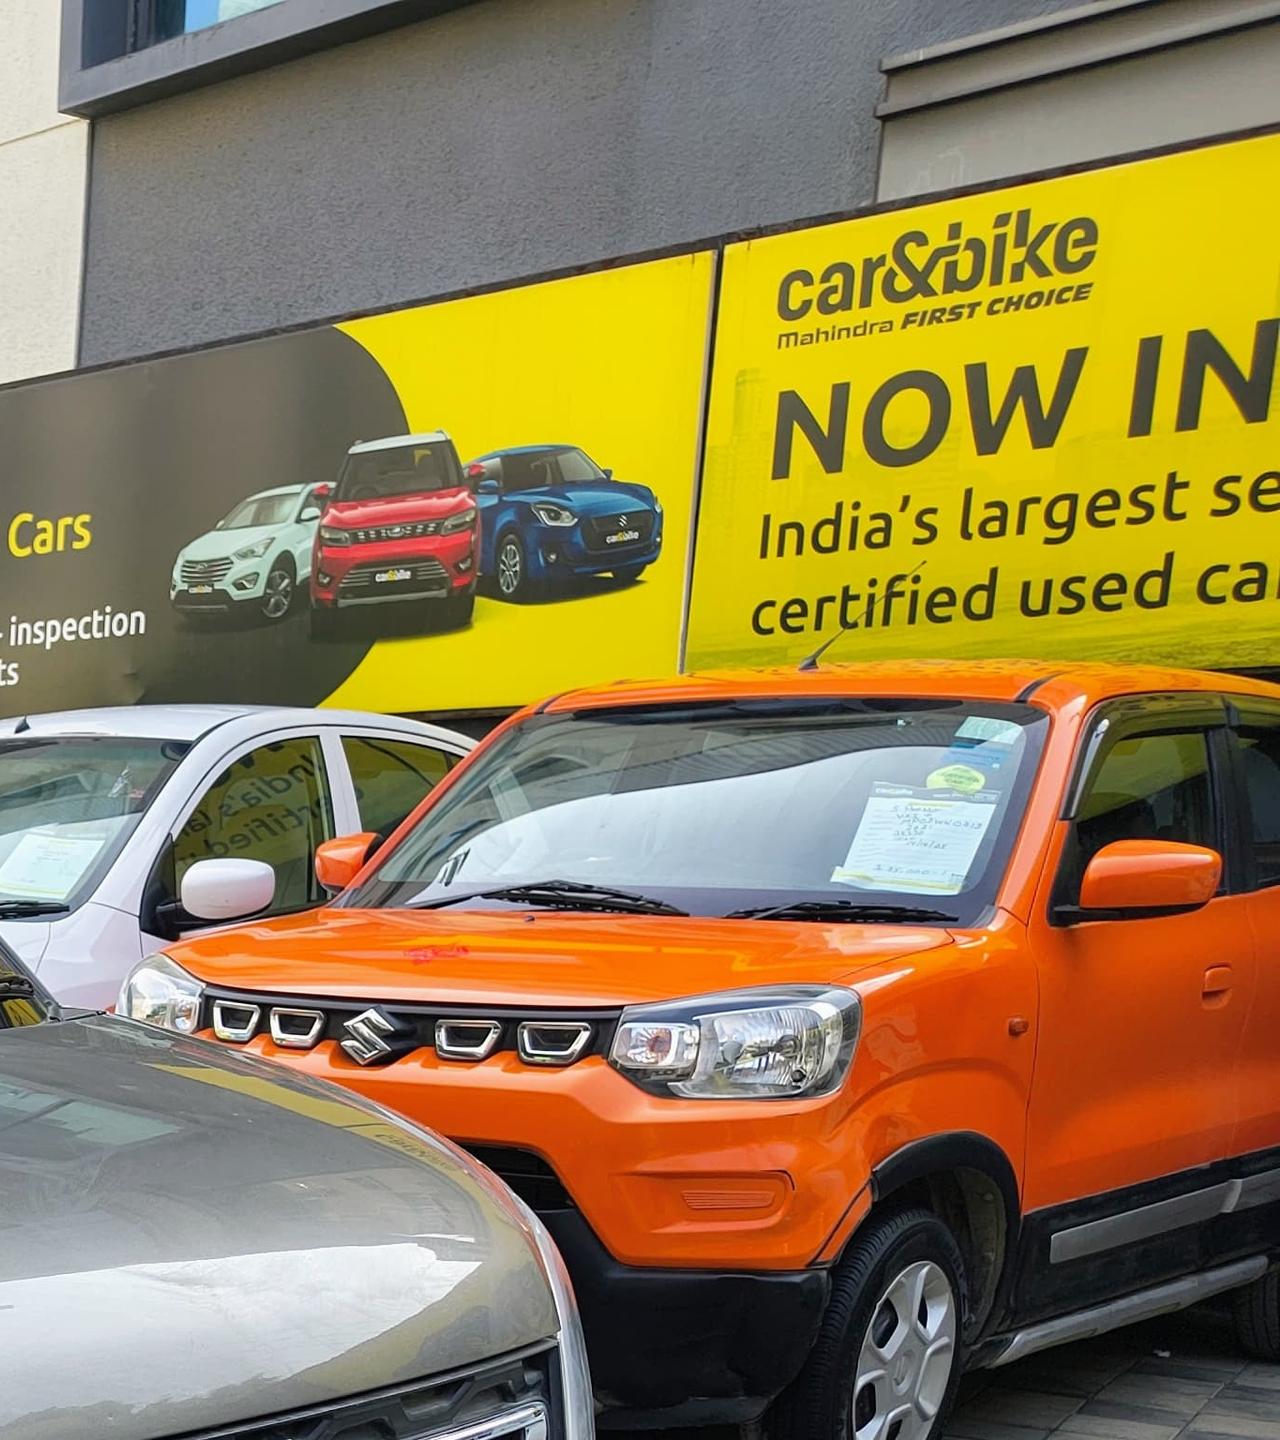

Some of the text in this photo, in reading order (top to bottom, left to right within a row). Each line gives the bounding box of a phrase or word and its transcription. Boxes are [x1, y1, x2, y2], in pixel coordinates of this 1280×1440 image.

[777, 208, 1098, 322] car&bike
[777, 282, 1094, 350] Mahindra FIRST CHOICE
[771, 318, 1280, 480] NOW IN
[7, 512, 93, 559] Cars
[960, 470, 1190, 545] largest
[1210, 469, 1280, 518] se
[9, 605, 146, 651] inspection
[751, 551, 1280, 636] certified used ca
